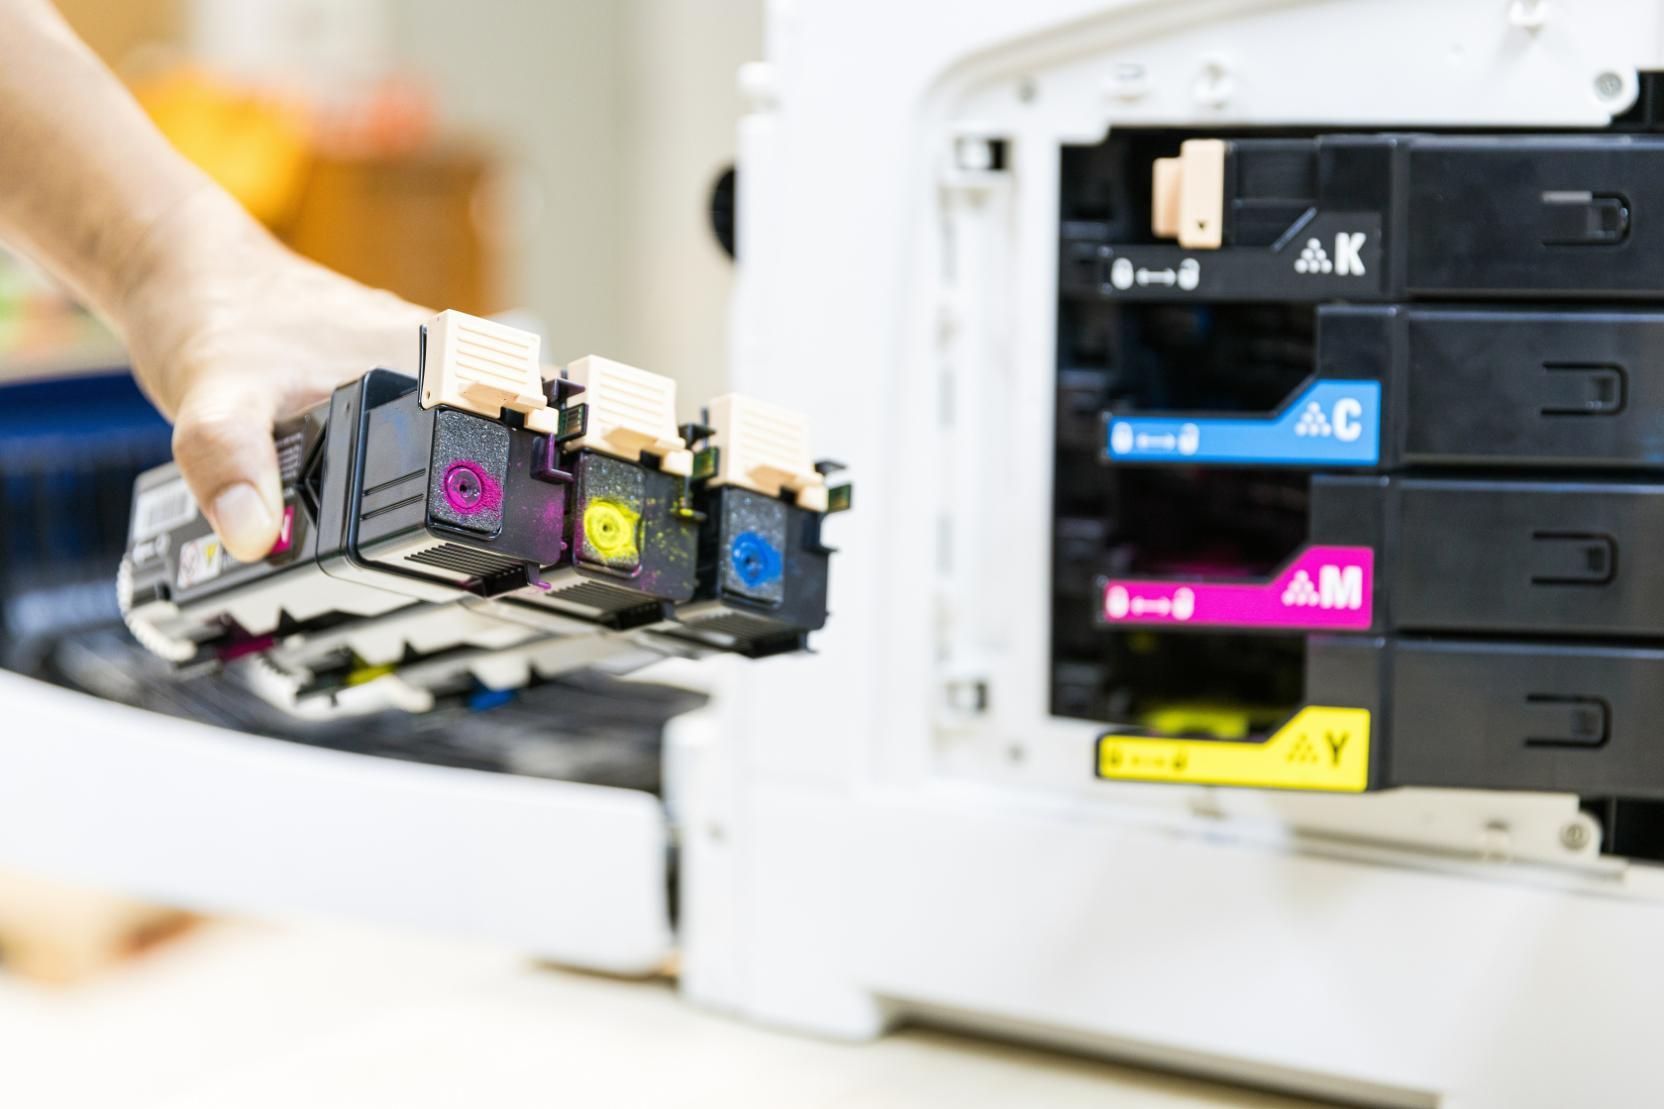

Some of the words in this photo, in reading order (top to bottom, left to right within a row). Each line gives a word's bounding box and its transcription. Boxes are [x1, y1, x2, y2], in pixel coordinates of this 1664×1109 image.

[1335, 232, 1366, 276] K
[1332, 398, 1362, 442] C
[1319, 564, 1363, 610] M
[1324, 731, 1350, 767] Y
